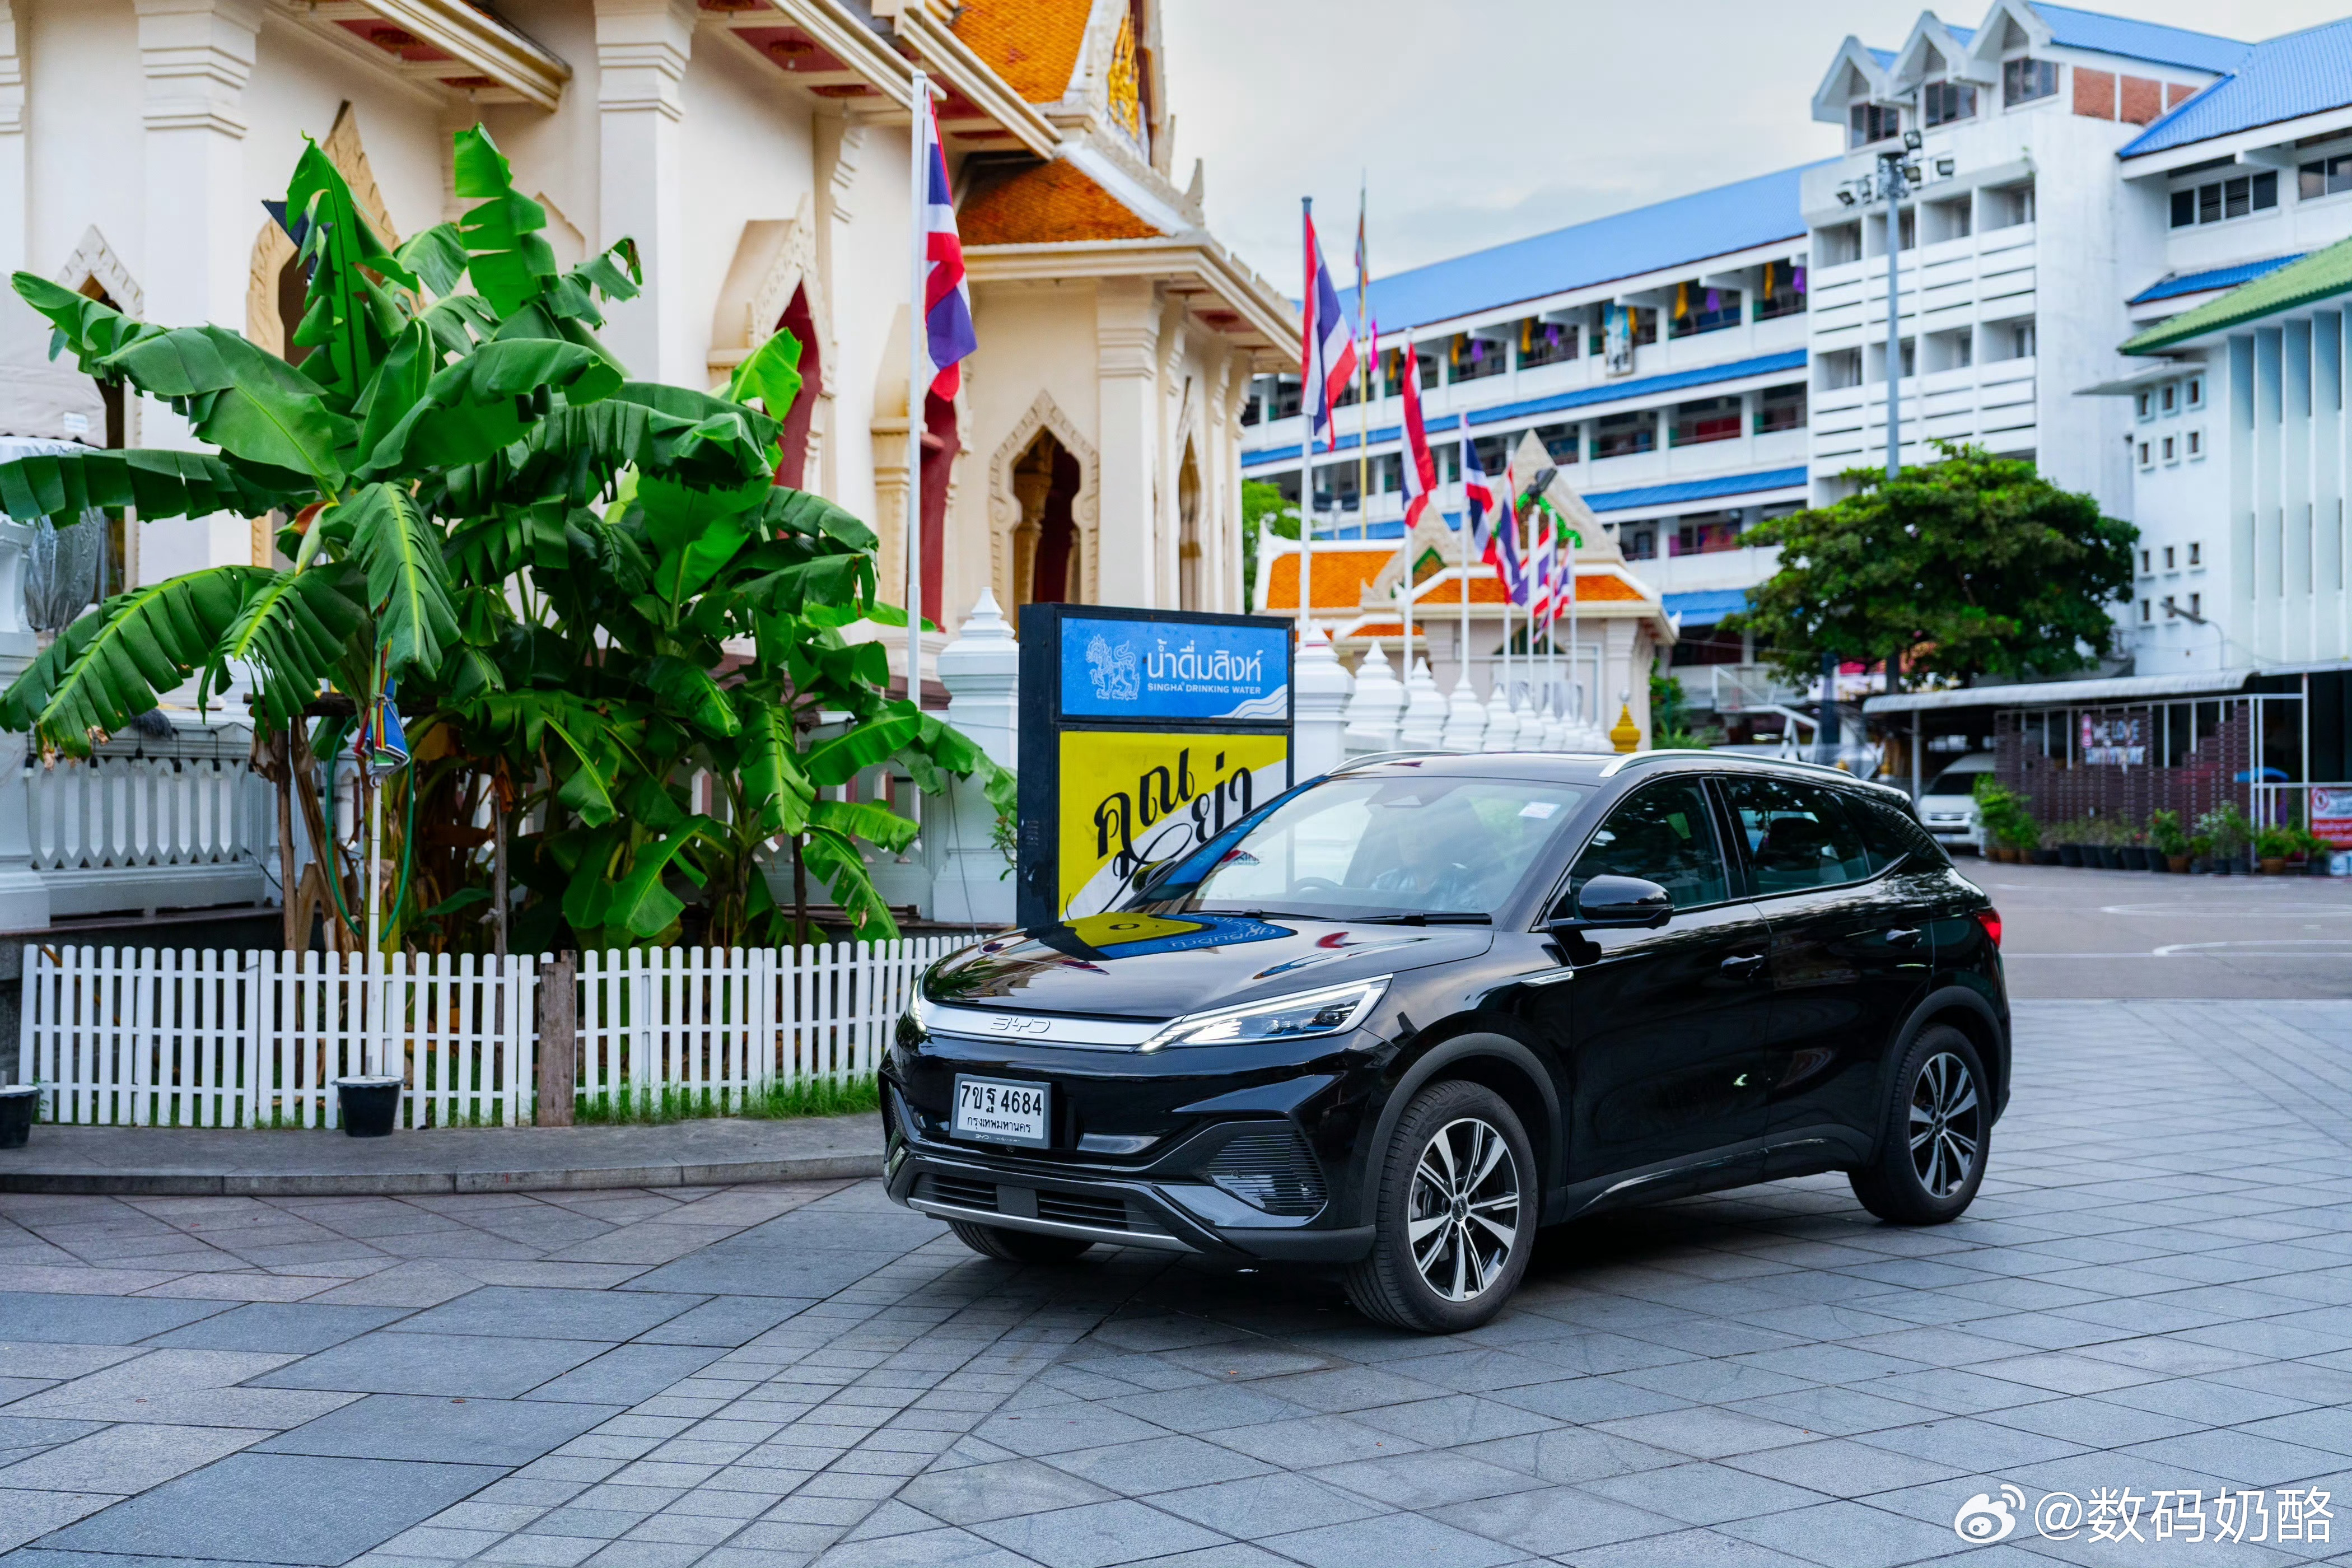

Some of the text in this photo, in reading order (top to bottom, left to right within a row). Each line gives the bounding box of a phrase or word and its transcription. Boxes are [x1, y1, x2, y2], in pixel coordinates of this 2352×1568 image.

[1147, 638, 1264, 682] น้ำดื่มสิงห์
[1147, 683, 1261, 694] SINGHA DRINKING WATER
[990, 1016, 1051, 1034] BYD
[961, 1084, 1042, 1116] 7ขฐ 4684
[967, 1116, 1032, 1133] กรุงเทพมหานคร
